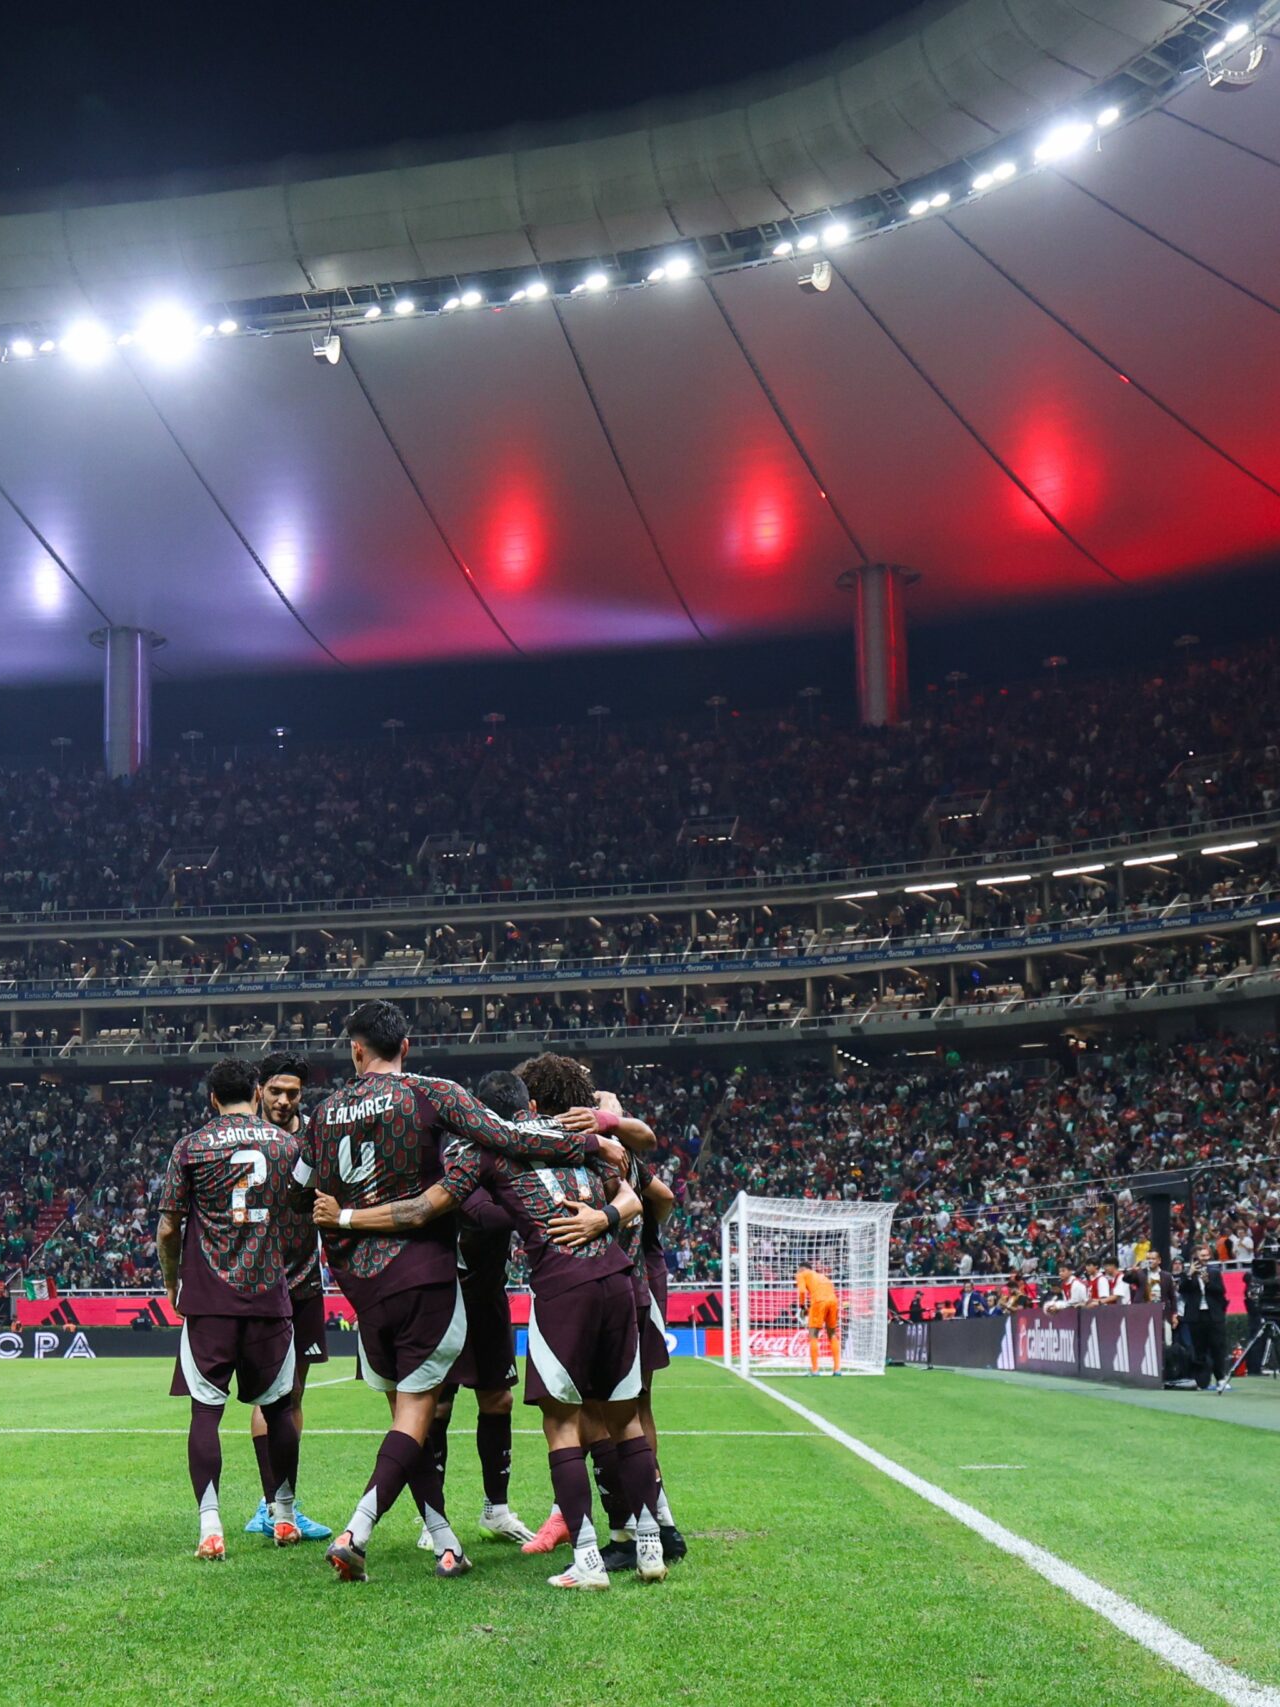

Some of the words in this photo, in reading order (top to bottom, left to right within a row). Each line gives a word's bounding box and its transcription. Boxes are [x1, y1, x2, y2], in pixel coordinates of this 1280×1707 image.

[230, 1150, 271, 1223] 2
[338, 1135, 378, 1204] 4
[1027, 1318, 1076, 1363] caliente.mx
